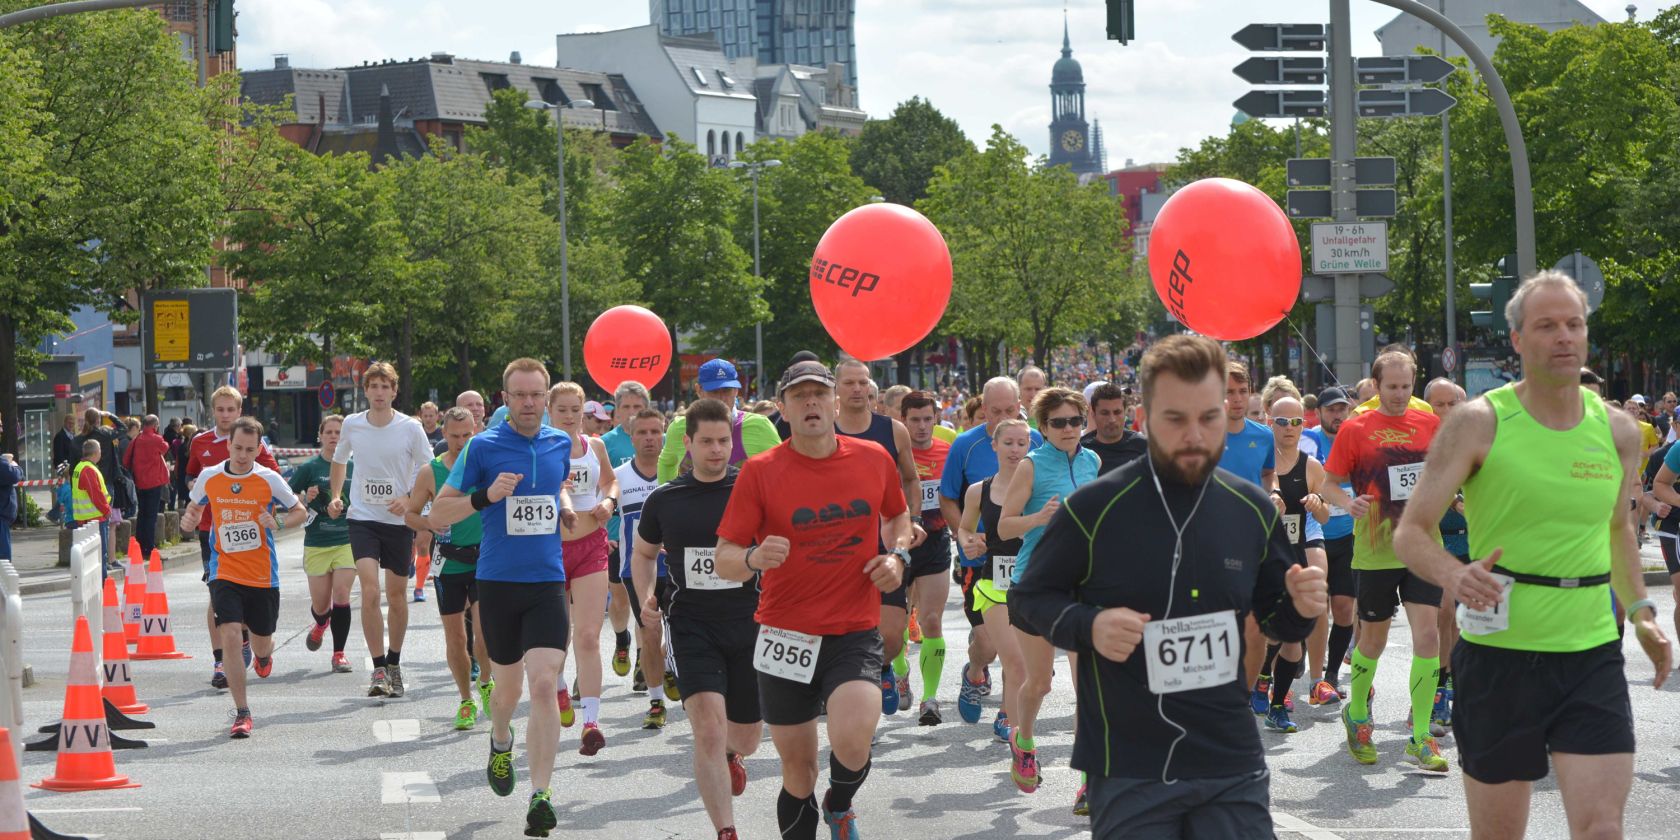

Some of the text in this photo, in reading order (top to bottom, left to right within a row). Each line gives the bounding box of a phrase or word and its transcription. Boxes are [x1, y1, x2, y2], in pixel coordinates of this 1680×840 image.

[1322, 235, 1376, 246] Unfallgefahr
[1331, 247, 1370, 258] 30 km/h
[1320, 259, 1382, 270] Grüne Welle
[825, 263, 880, 297] cep
[629, 354, 661, 371] cep
[573, 470, 588, 484] 41
[1400, 472, 1417, 487] 53
[365, 484, 393, 496] 1008
[622, 486, 646, 496] SIGNAL
[512, 505, 554, 522] 4813
[224, 528, 258, 543] 1366
[691, 557, 715, 575] 49
[1161, 621, 1191, 635] hella
[762, 638, 813, 668] 7956
[1158, 629, 1230, 667] 6711
[1183, 662, 1216, 674] Michael
